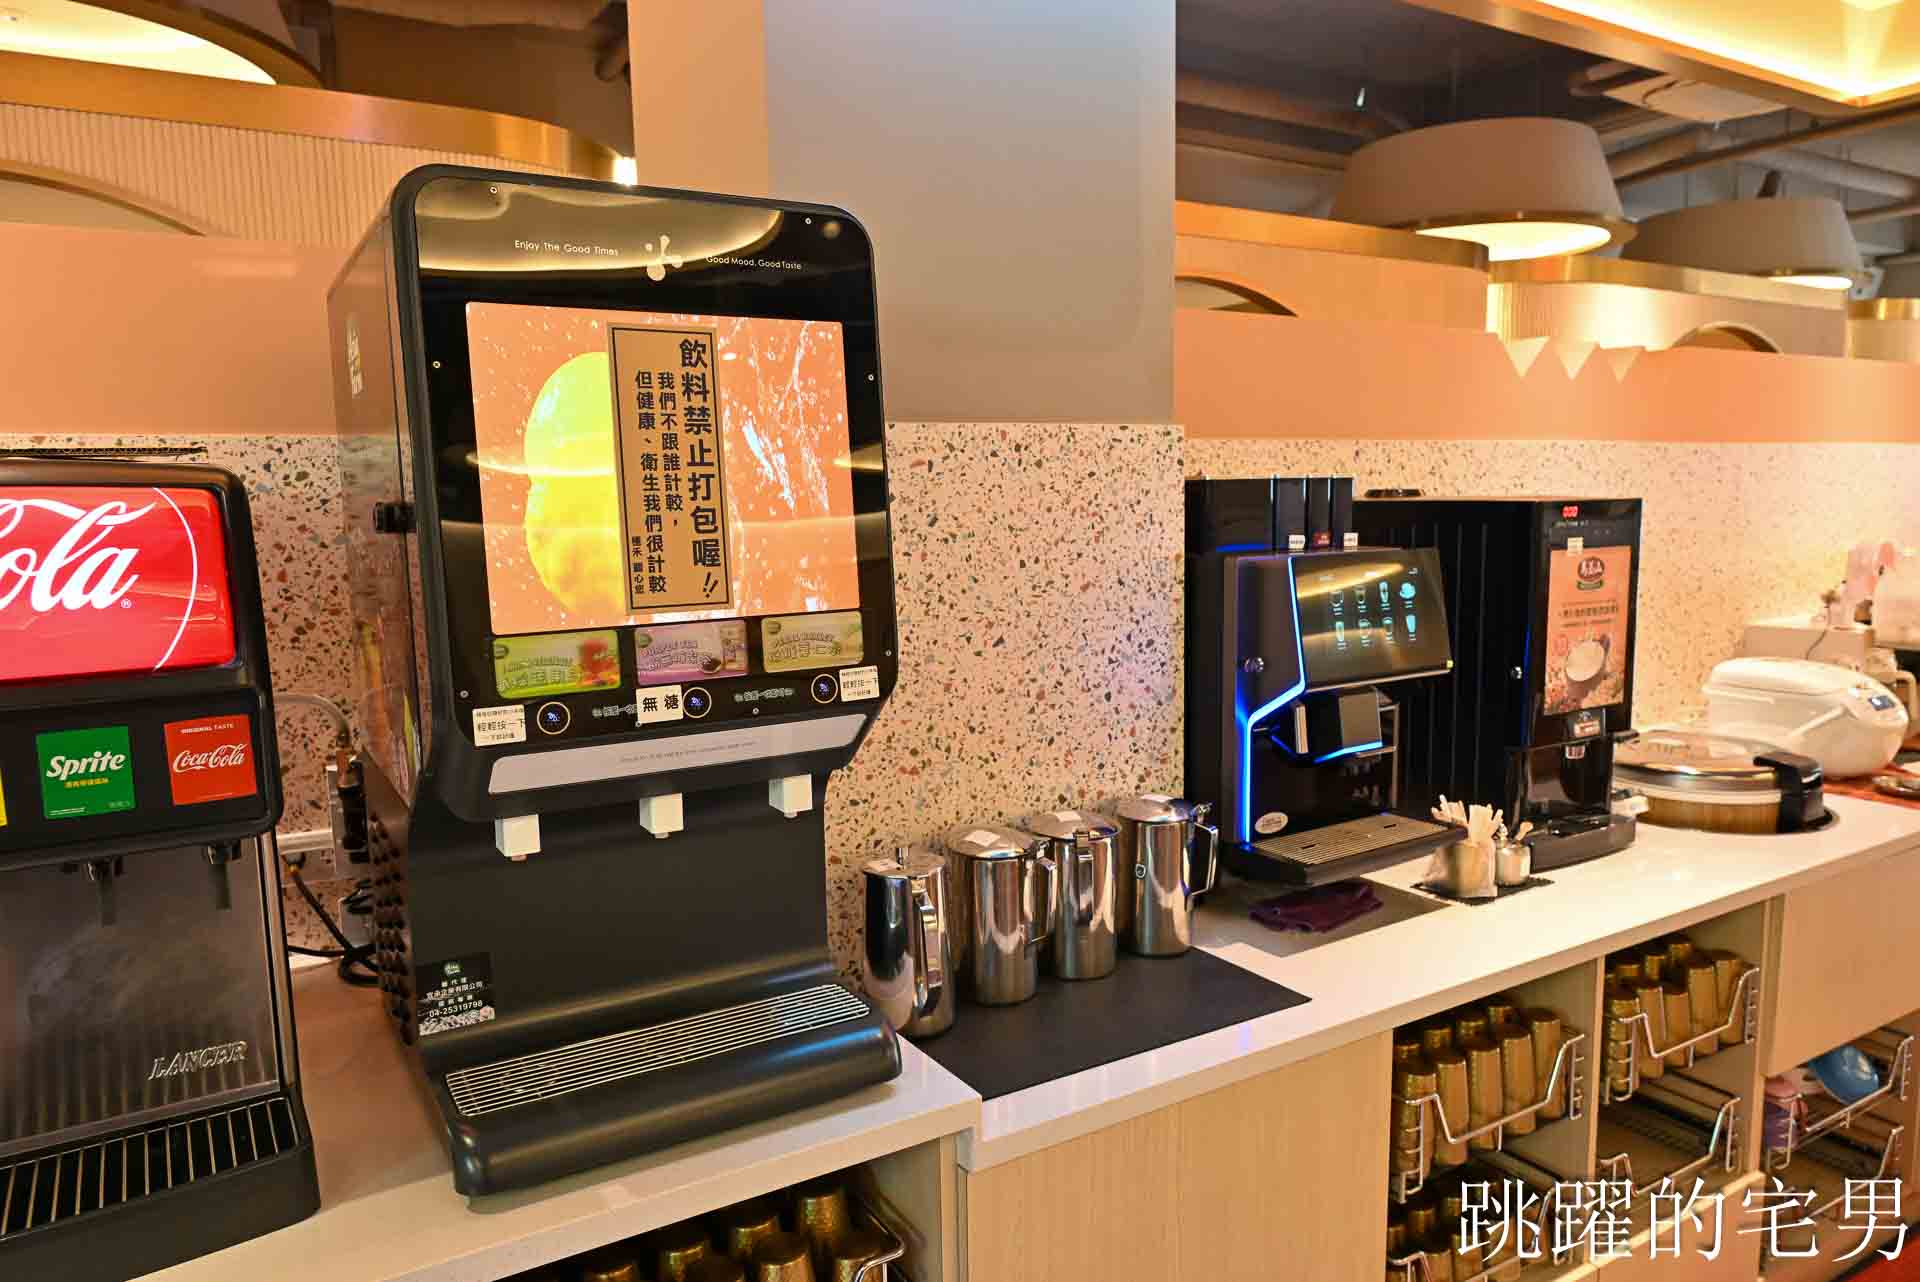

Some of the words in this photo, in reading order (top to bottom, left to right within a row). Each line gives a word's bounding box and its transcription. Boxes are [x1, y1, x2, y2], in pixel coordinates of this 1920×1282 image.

[515, 239, 541, 253] Enjoy
[543, 241, 560, 252] The
[563, 243, 591, 255] Good
[593, 245, 619, 257] Times
[706, 254, 730, 265] Good
[758, 259, 780, 269] Good
[635, 370, 667, 594] 但健康、衛生我們很計較
[0, 499, 156, 612] ola
[642, 694, 680, 712] 無糖
[213, 723, 235, 731] TASTE
[46, 751, 126, 780] Sprite
[173, 743, 248, 774] Coca-Cola
[147, 1040, 247, 1081] LANCER
